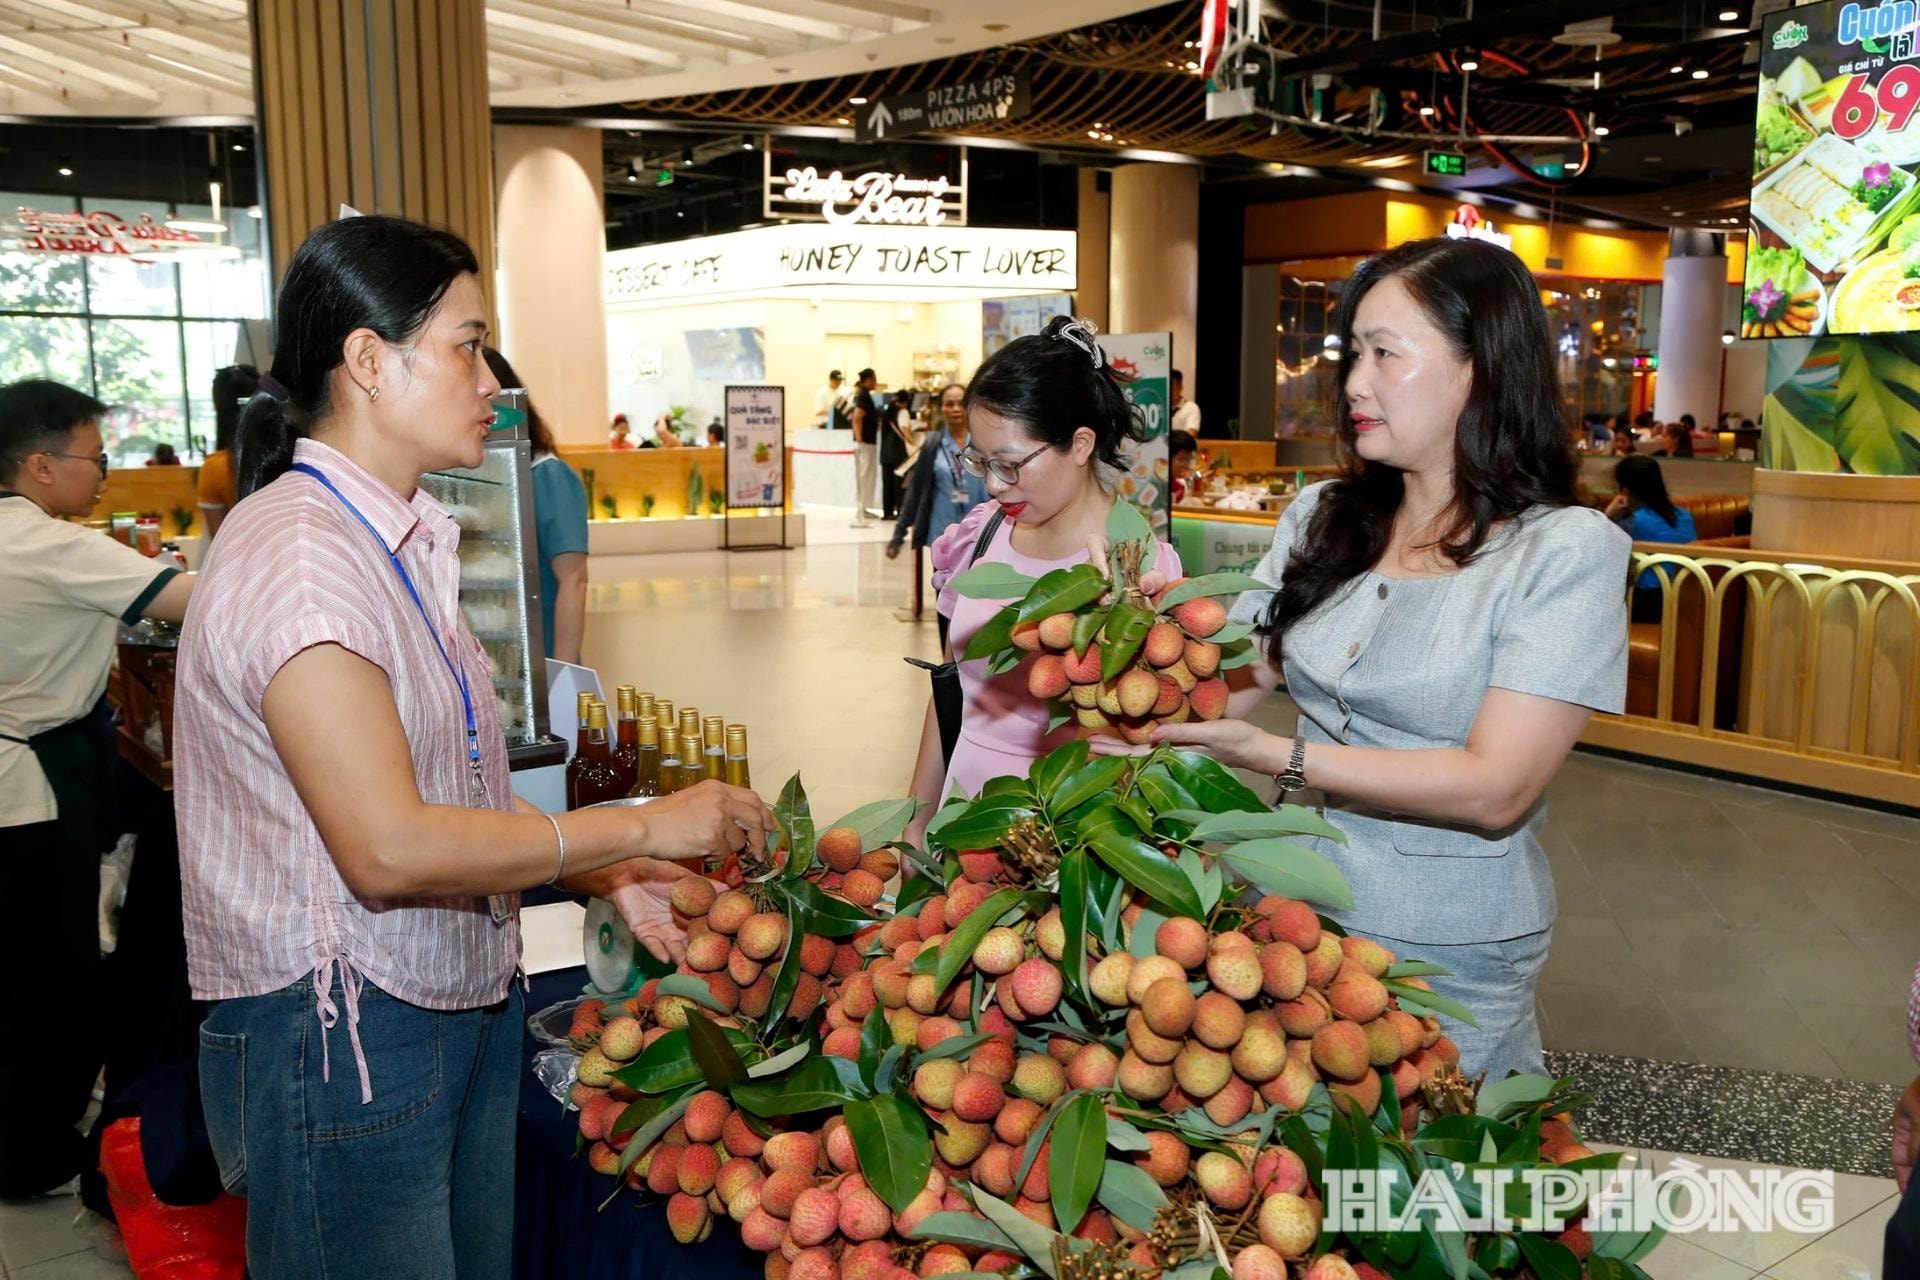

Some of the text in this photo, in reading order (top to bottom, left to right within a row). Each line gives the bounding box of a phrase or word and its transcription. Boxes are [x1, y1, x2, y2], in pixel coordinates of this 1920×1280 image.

[928, 83, 977, 107] PIZZA
[966, 103, 994, 121] HOA
[822, 172, 947, 226] Bear
[780, 244, 1070, 275] HONEY TOAST LOVER
